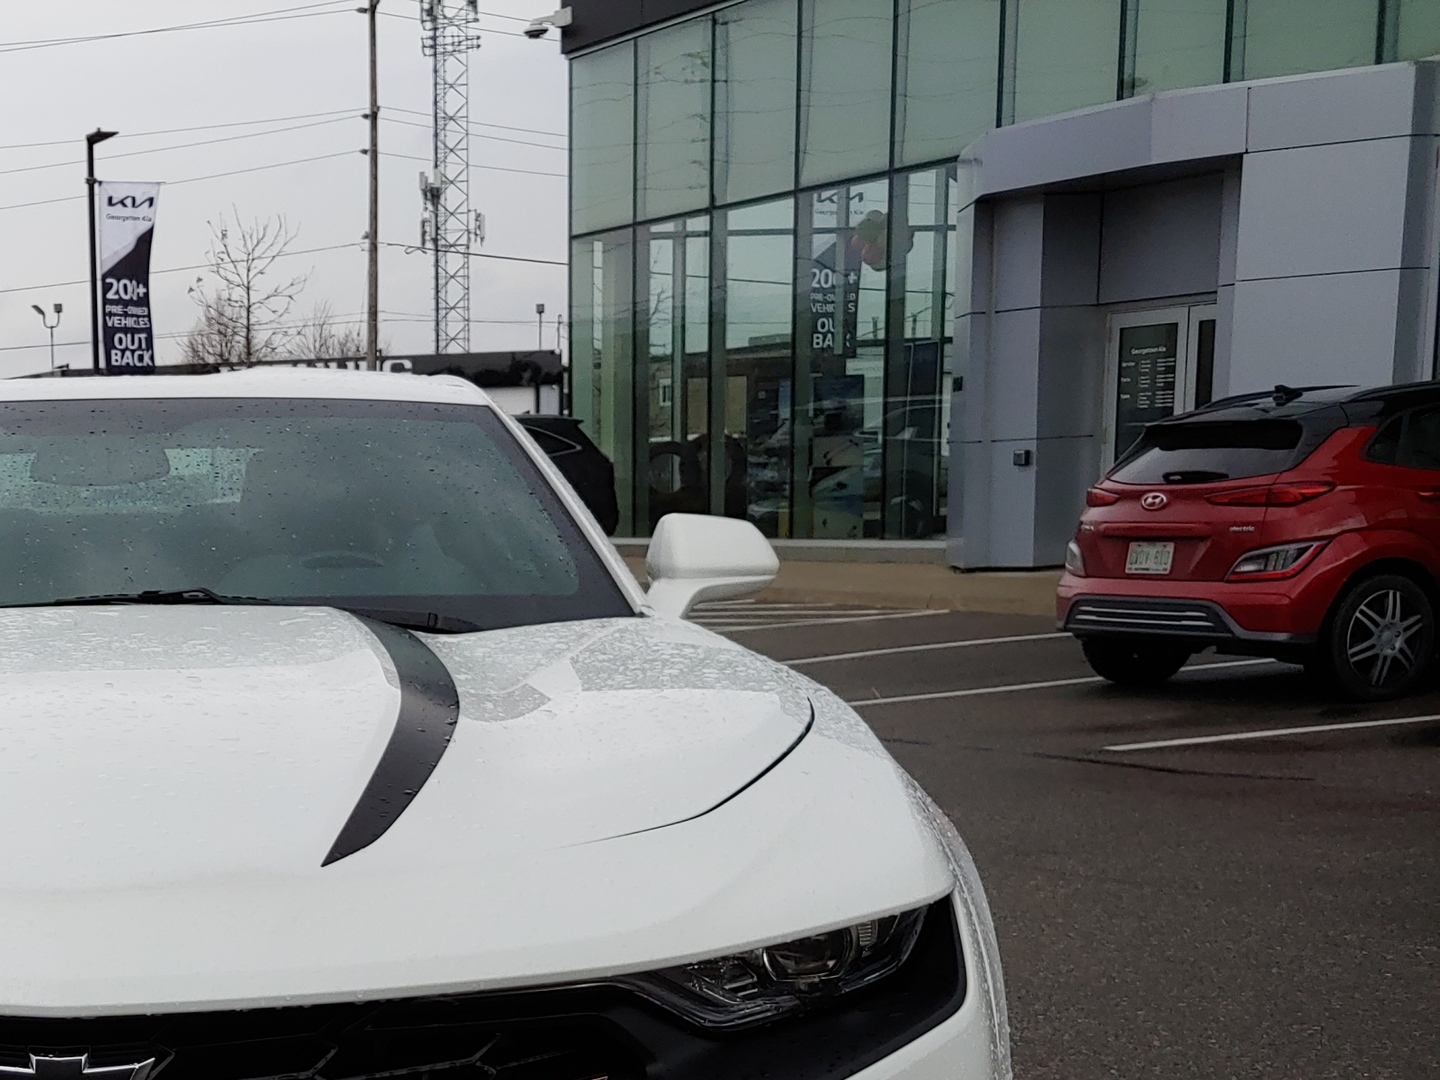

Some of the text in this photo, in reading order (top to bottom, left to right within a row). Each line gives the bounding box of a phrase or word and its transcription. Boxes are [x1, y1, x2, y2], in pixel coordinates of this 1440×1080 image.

[107, 195, 155, 209] KIA
[811, 268, 858, 289] 20+
[113, 333, 148, 350] OUT
[111, 349, 153, 367] BACK
